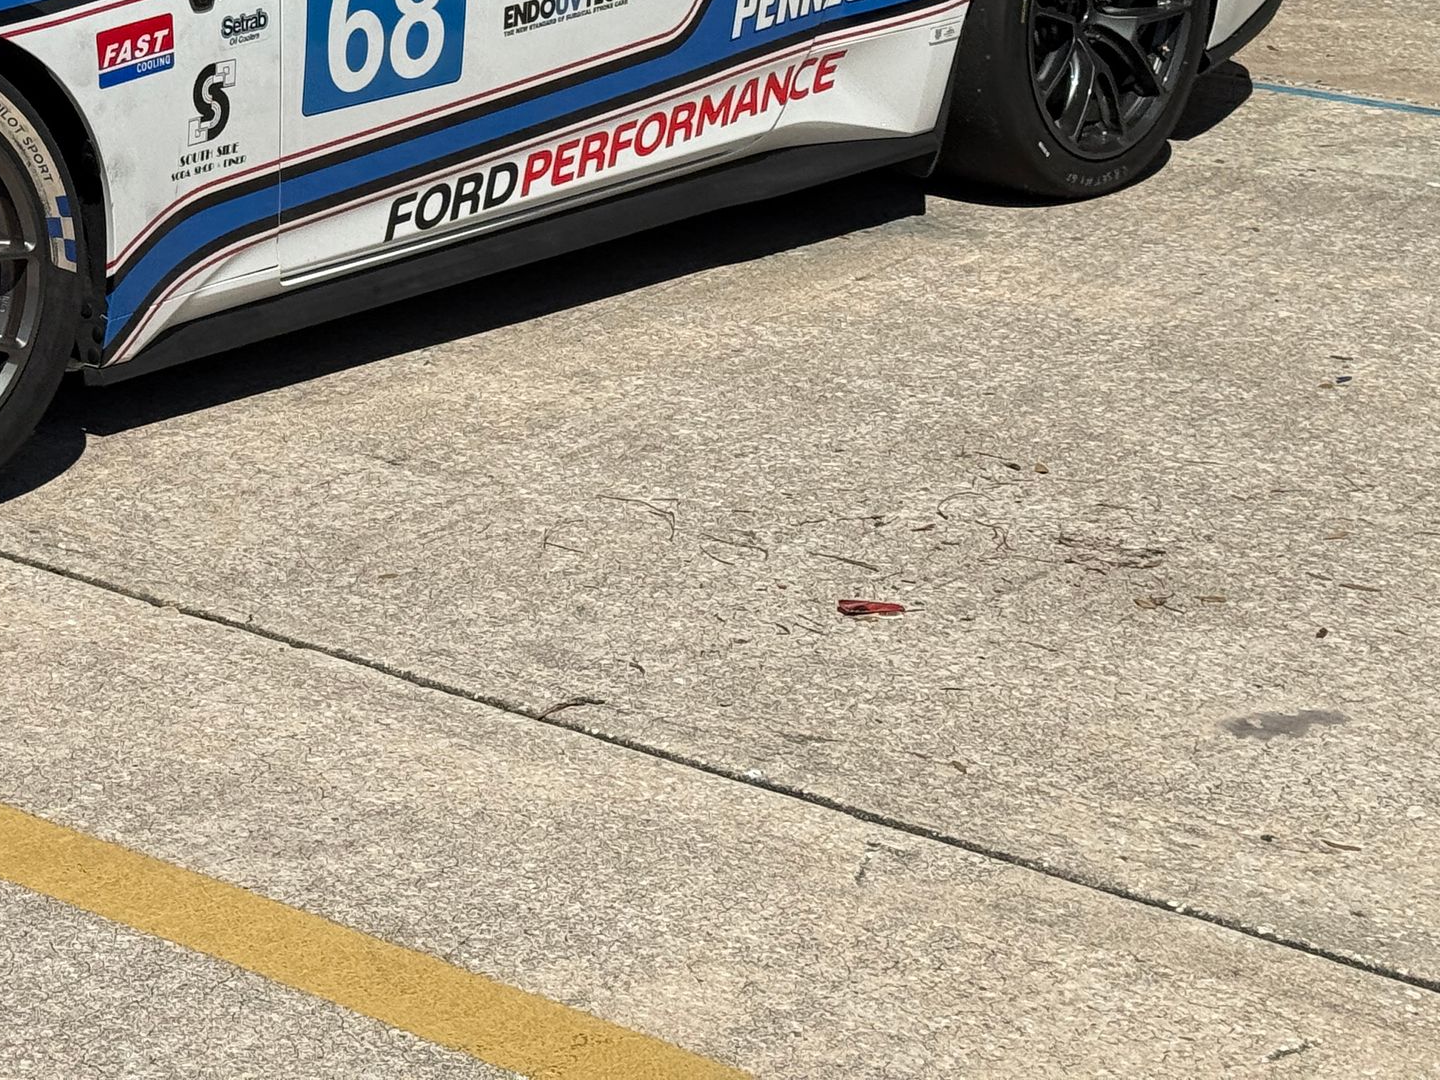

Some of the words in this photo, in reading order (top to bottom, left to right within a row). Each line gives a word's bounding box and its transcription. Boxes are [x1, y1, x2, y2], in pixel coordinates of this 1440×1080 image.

[222, 10, 268, 38] Setrab
[102, 29, 169, 69] FAST
[136, 55, 171, 73] COOLING
[21, 136, 54, 184] SPORT
